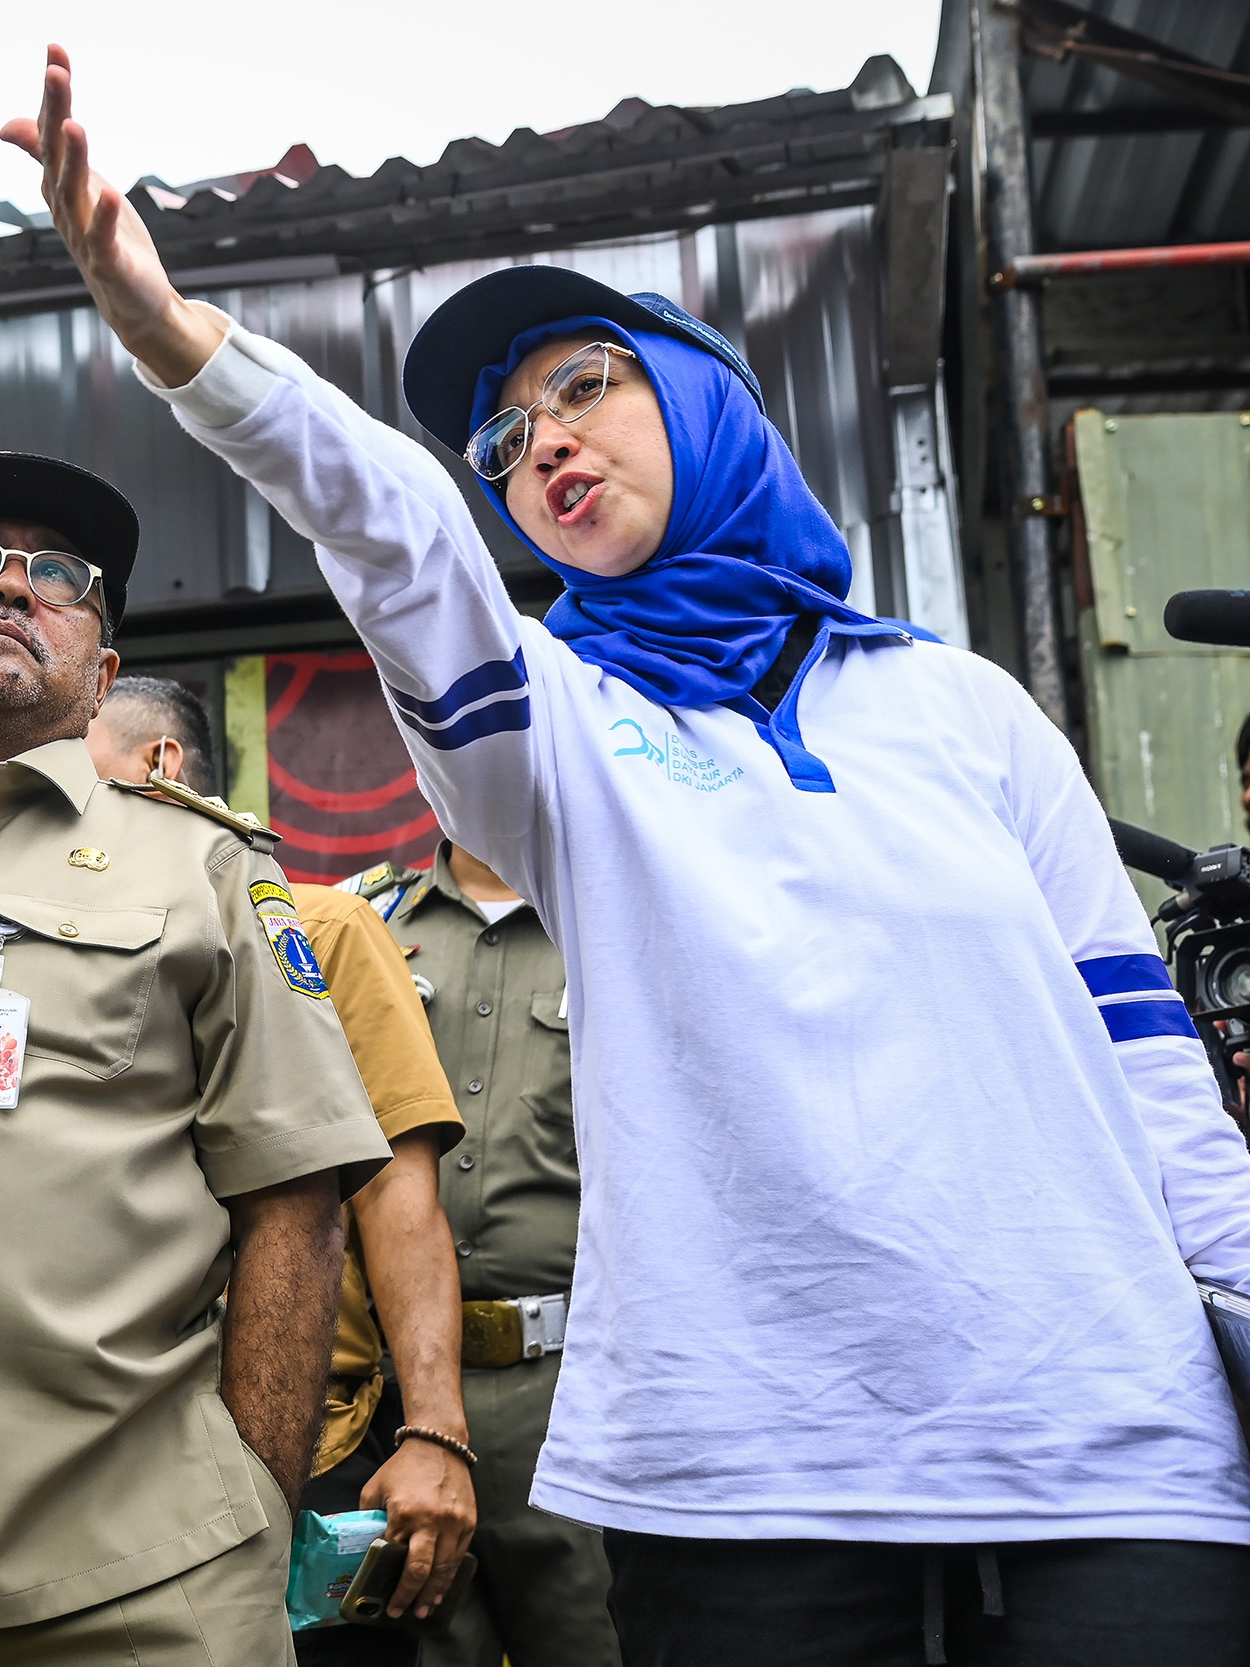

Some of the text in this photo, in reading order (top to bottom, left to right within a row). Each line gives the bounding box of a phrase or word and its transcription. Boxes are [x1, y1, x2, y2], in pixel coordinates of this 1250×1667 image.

[673, 767, 745, 793] DKI JAKARTA
[701, 769, 721, 781] AIR
[269, 917, 287, 927] JAYA
